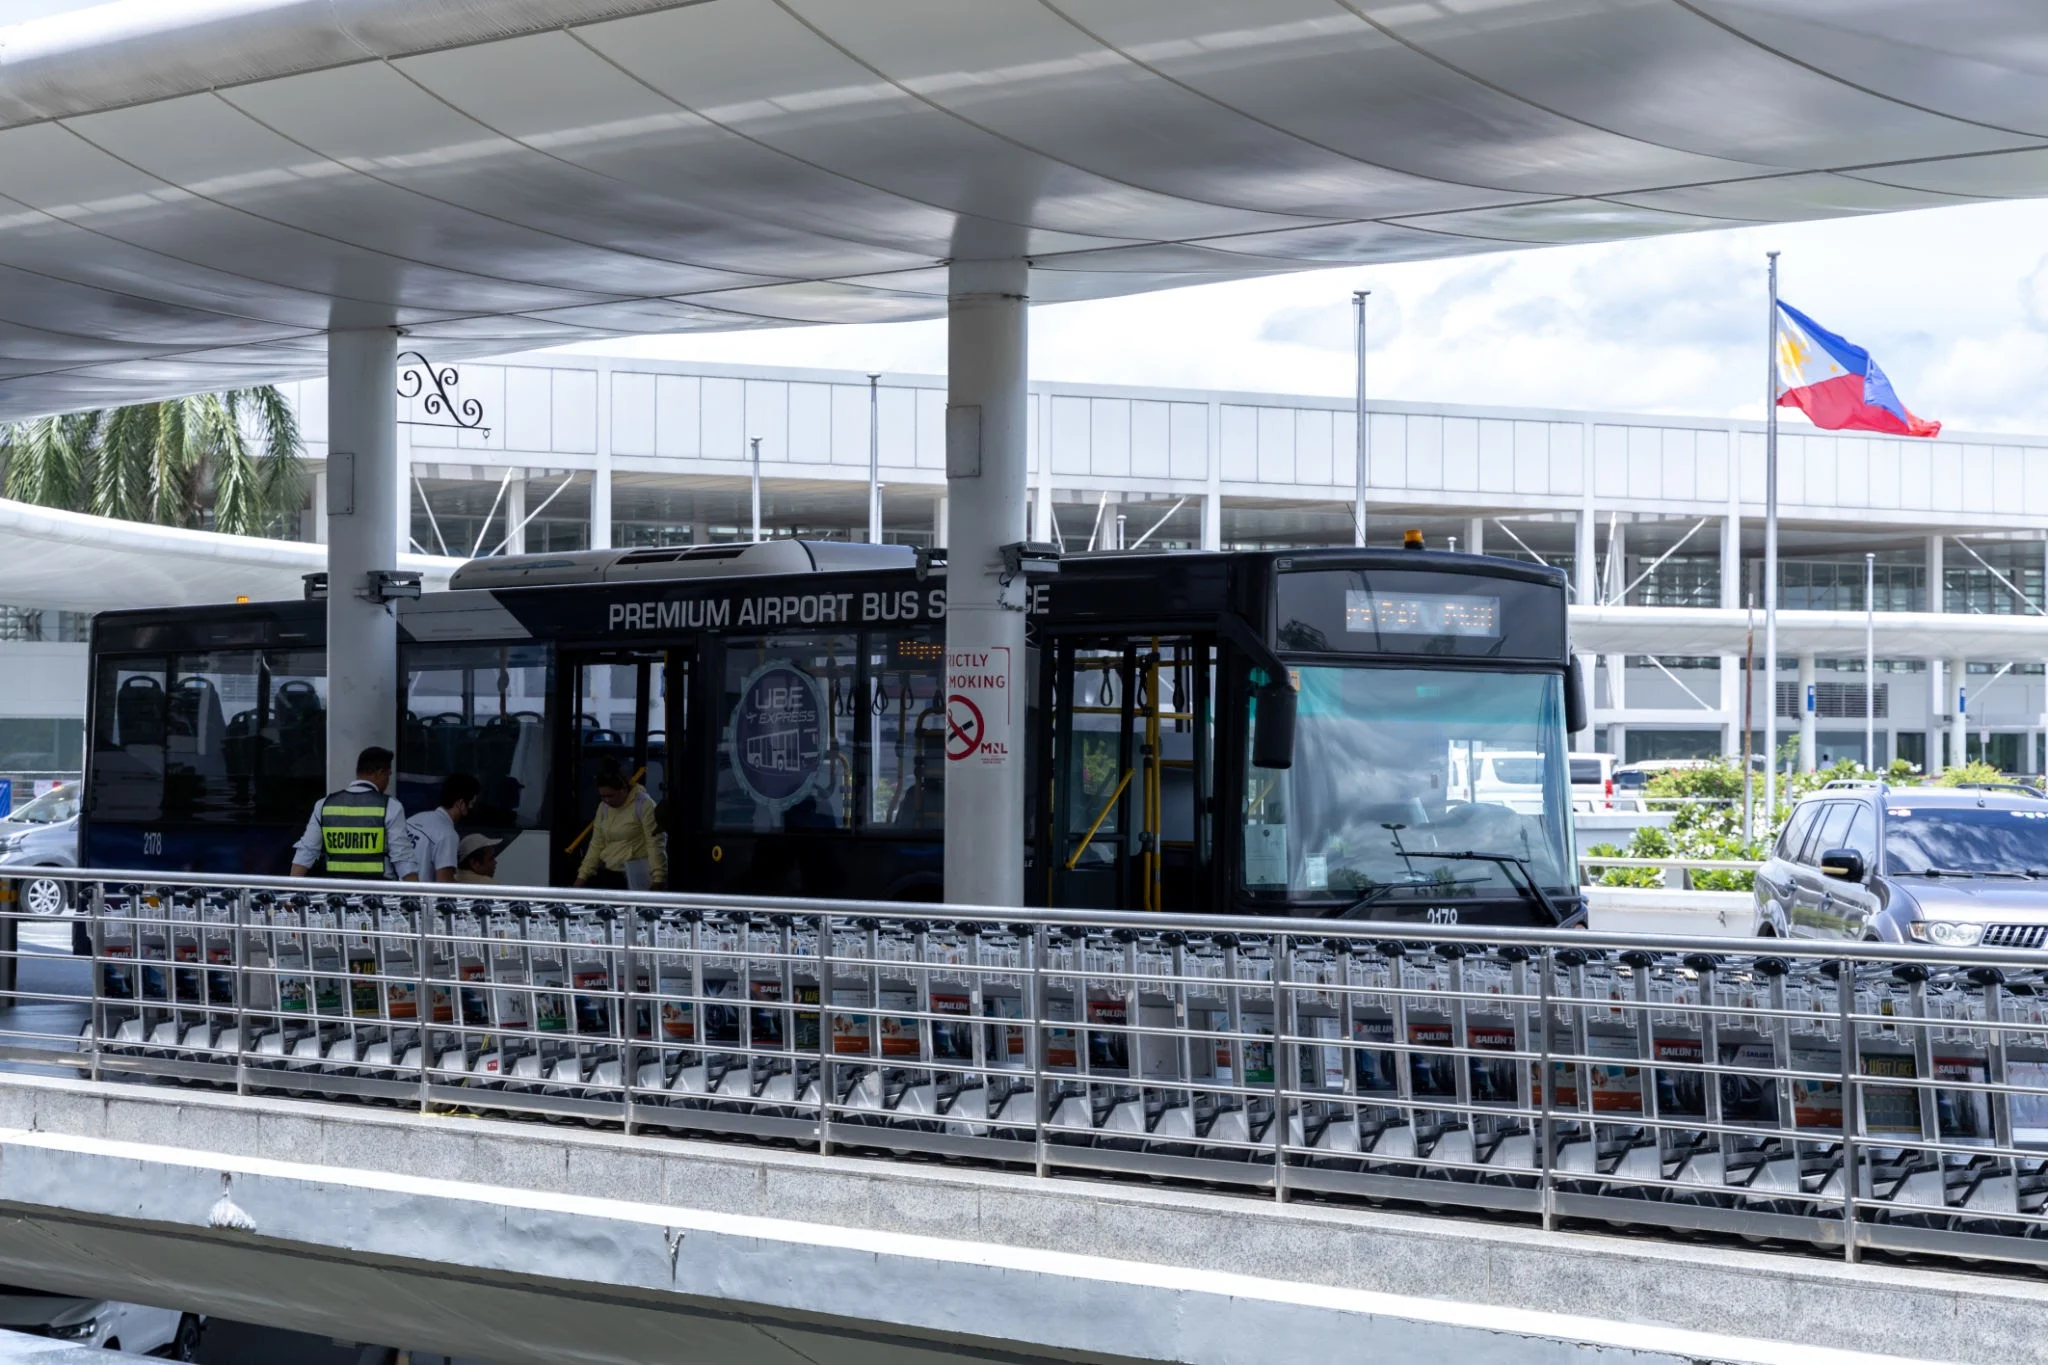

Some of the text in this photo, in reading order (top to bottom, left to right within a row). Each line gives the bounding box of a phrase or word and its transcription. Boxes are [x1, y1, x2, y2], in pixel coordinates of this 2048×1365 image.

[609, 600, 730, 630] PREMIUM
[737, 594, 854, 626] AIRPORT
[862, 590, 919, 622] BUS
[948, 654, 988, 667] RICTLY
[949, 675, 1005, 689] MOKING
[755, 686, 804, 710] UBE
[759, 710, 816, 724] EXPRESS
[143, 832, 162, 855] 2178
[326, 832, 378, 849] SECURITY
[1416, 1031, 1450, 1041] SAILUN
[1475, 1035, 1507, 1045] SAILUN
[1660, 1047, 1692, 1057] SAILUN
[1938, 1064, 1967, 1075] SAILUN
